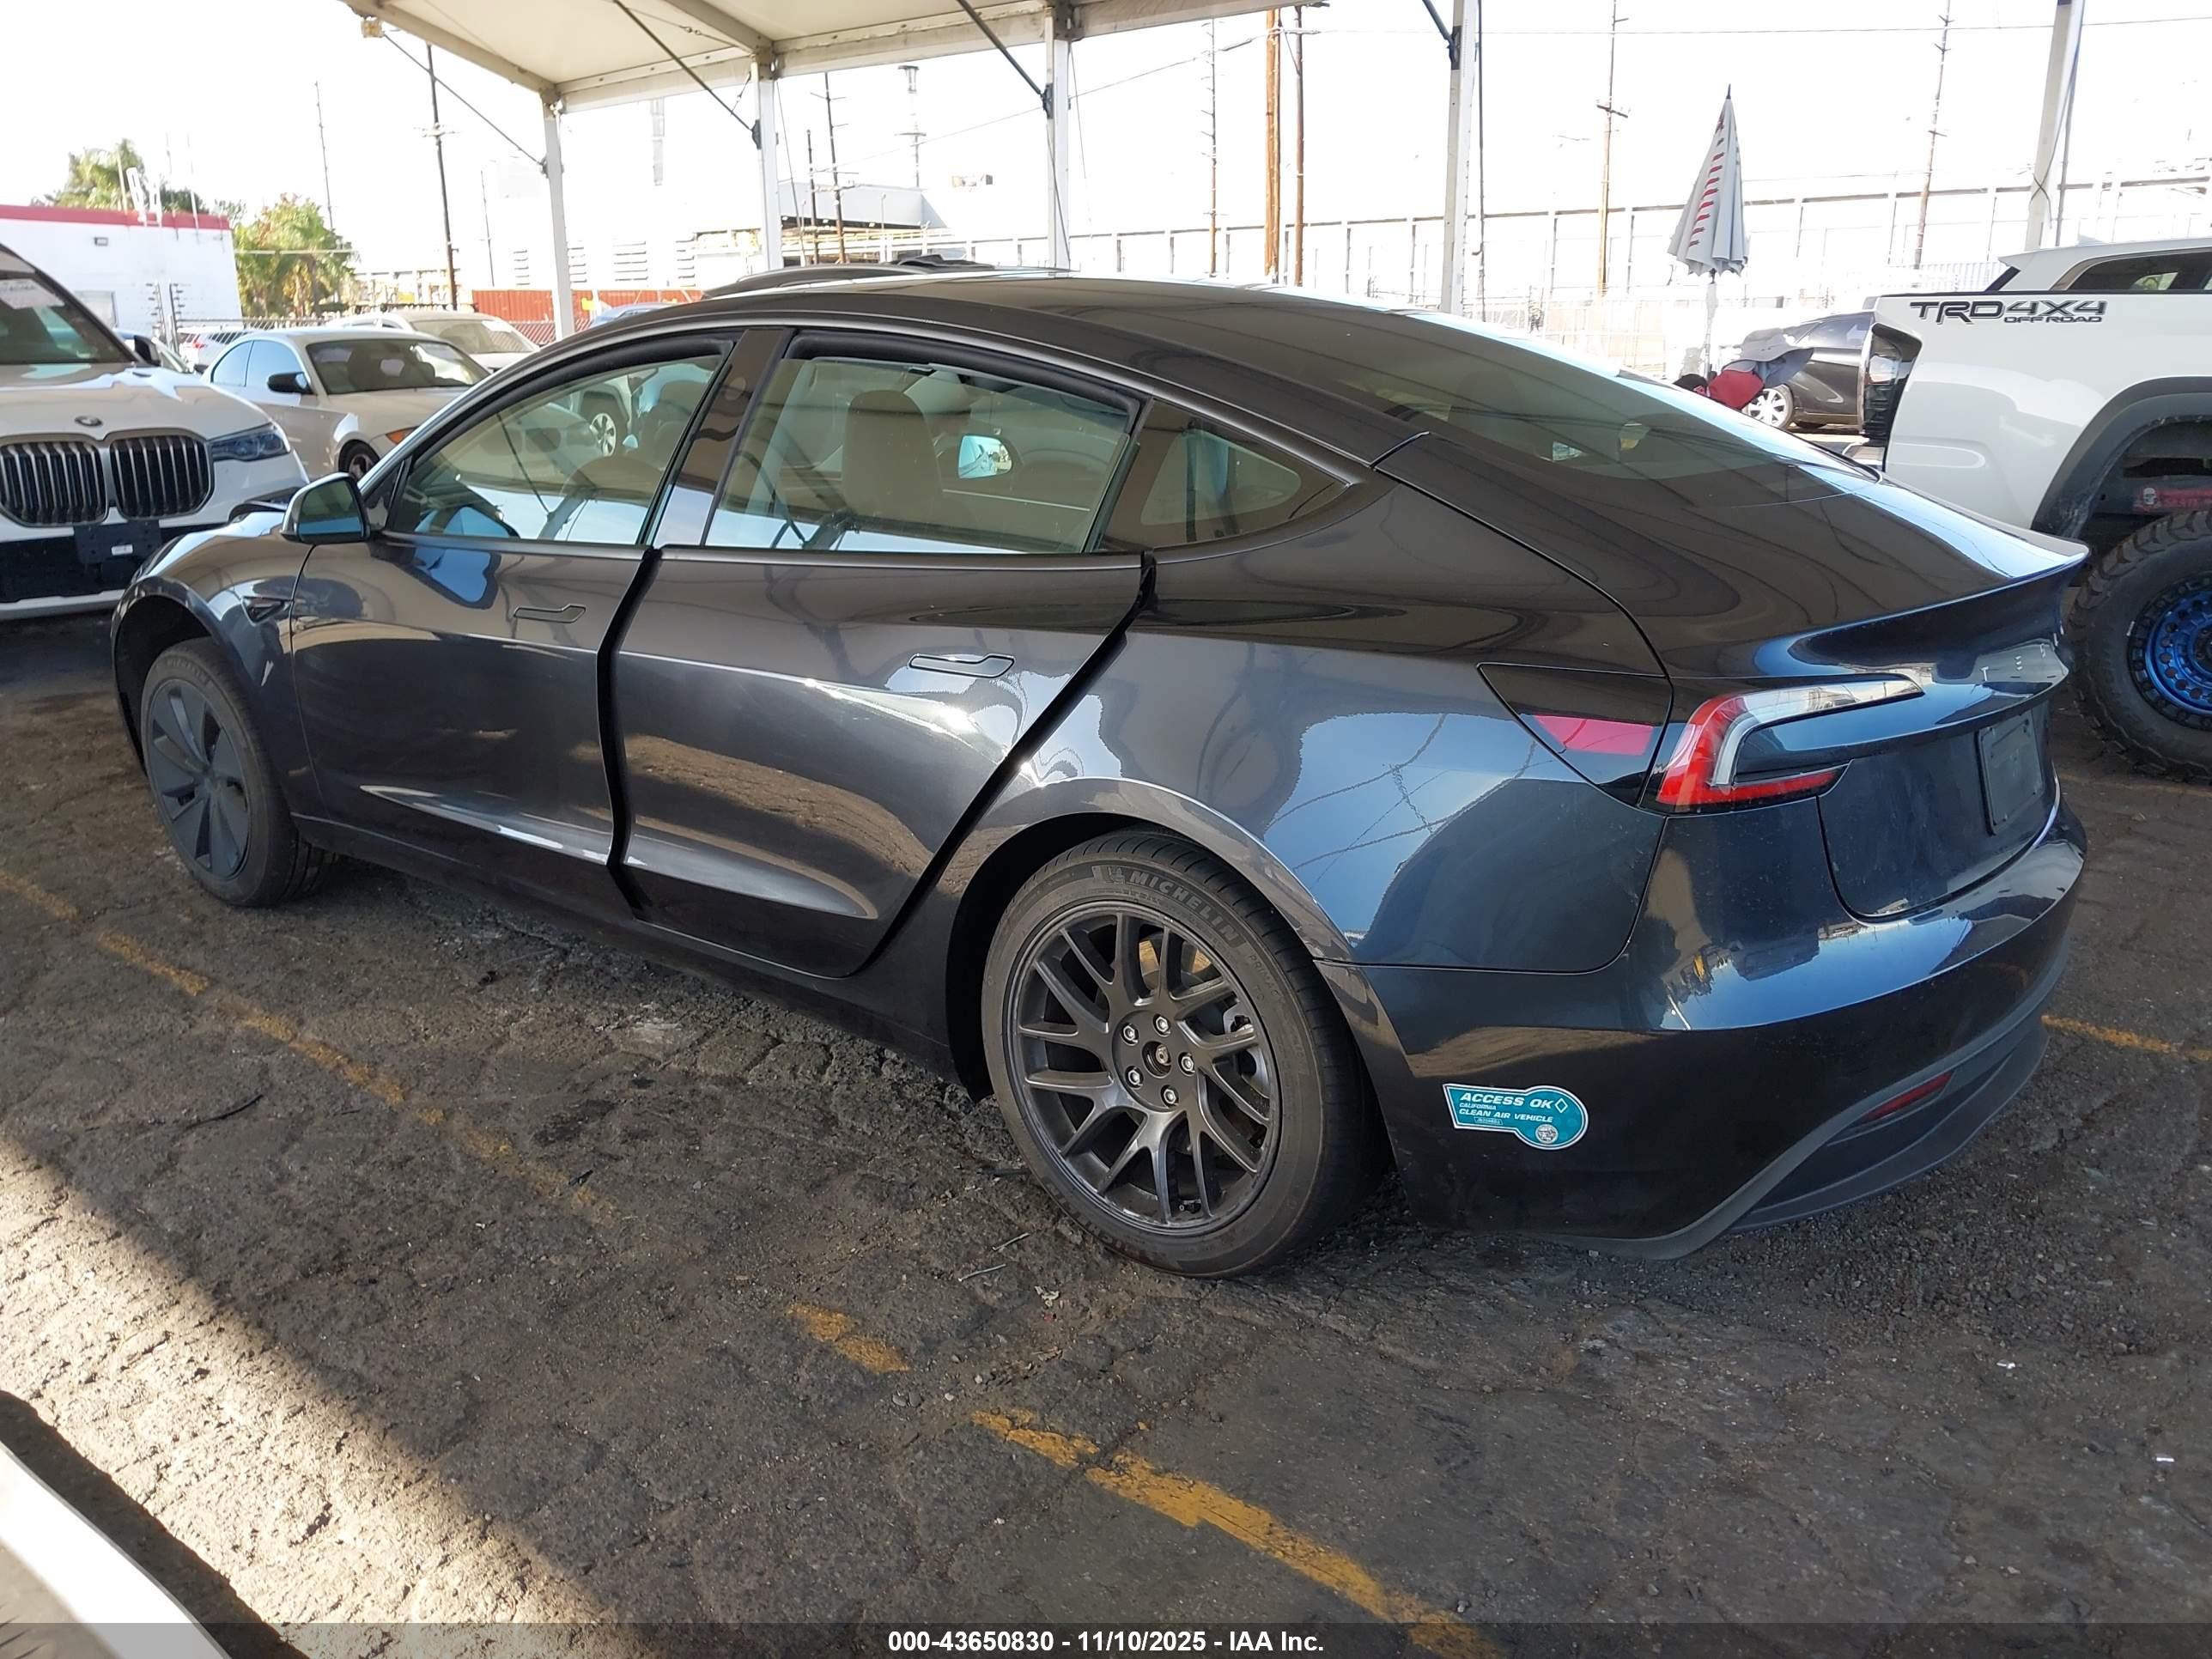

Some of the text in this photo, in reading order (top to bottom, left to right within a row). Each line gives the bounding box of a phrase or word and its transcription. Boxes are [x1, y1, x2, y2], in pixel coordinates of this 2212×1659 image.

[1909, 301, 2004, 325] TRD
[1129, 870, 1239, 942] MICHELIN
[1460, 1092, 1554, 1109] ACCESS OK
[1459, 1108, 1491, 1117] CLEAN
[1493, 1111, 1511, 1120] AIR
[1514, 1113, 1553, 1122] VEHICLE
